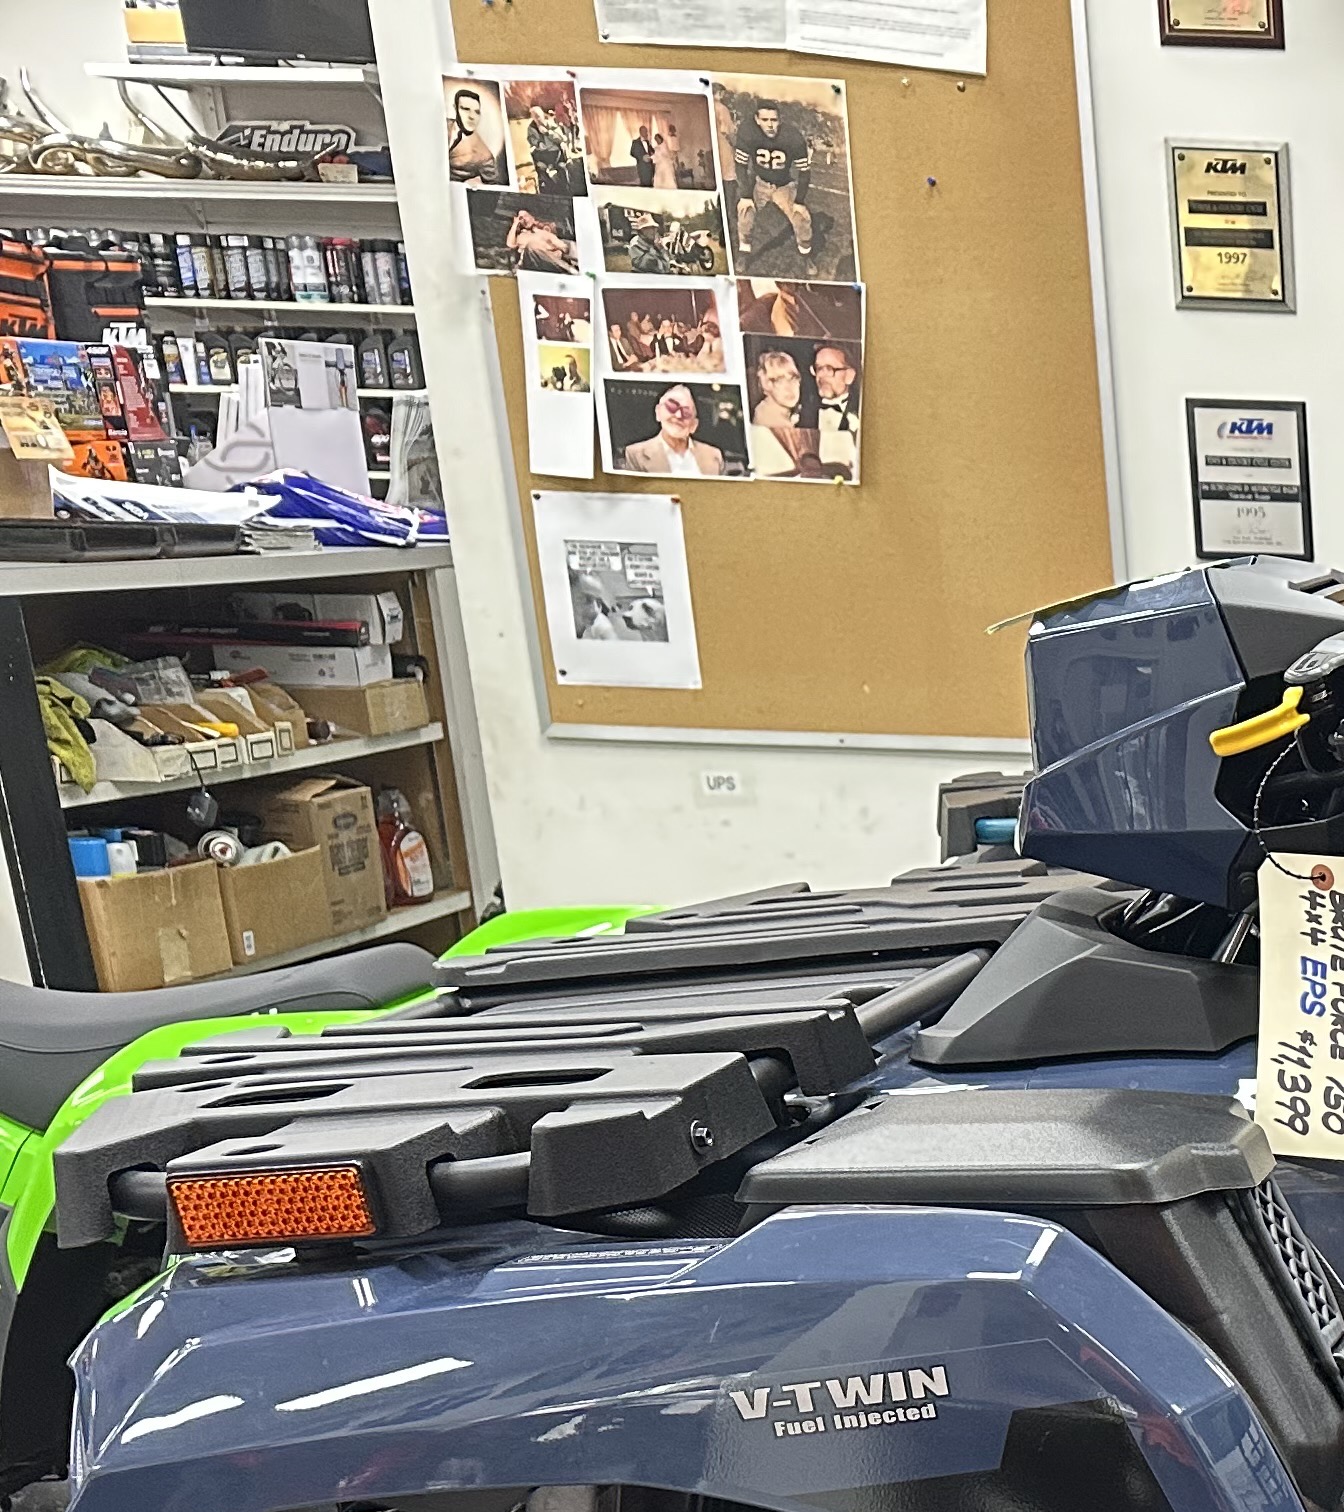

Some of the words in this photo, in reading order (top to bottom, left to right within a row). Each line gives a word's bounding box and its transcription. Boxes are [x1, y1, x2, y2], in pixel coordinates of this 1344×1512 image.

[250, 129, 348, 152] Enduro
[756, 148, 786, 170] 22
[1204, 158, 1248, 175] KTM
[1217, 252, 1248, 265] 1997
[102, 322, 148, 345] KTM
[1229, 418, 1274, 436] KTM
[706, 775, 736, 792] UPS
[1299, 955, 1328, 1018] EPS
[729, 1365, 949, 1421] V-TWIN
[774, 1416, 826, 1437] Fuel
[834, 1403, 937, 1430] Injected
